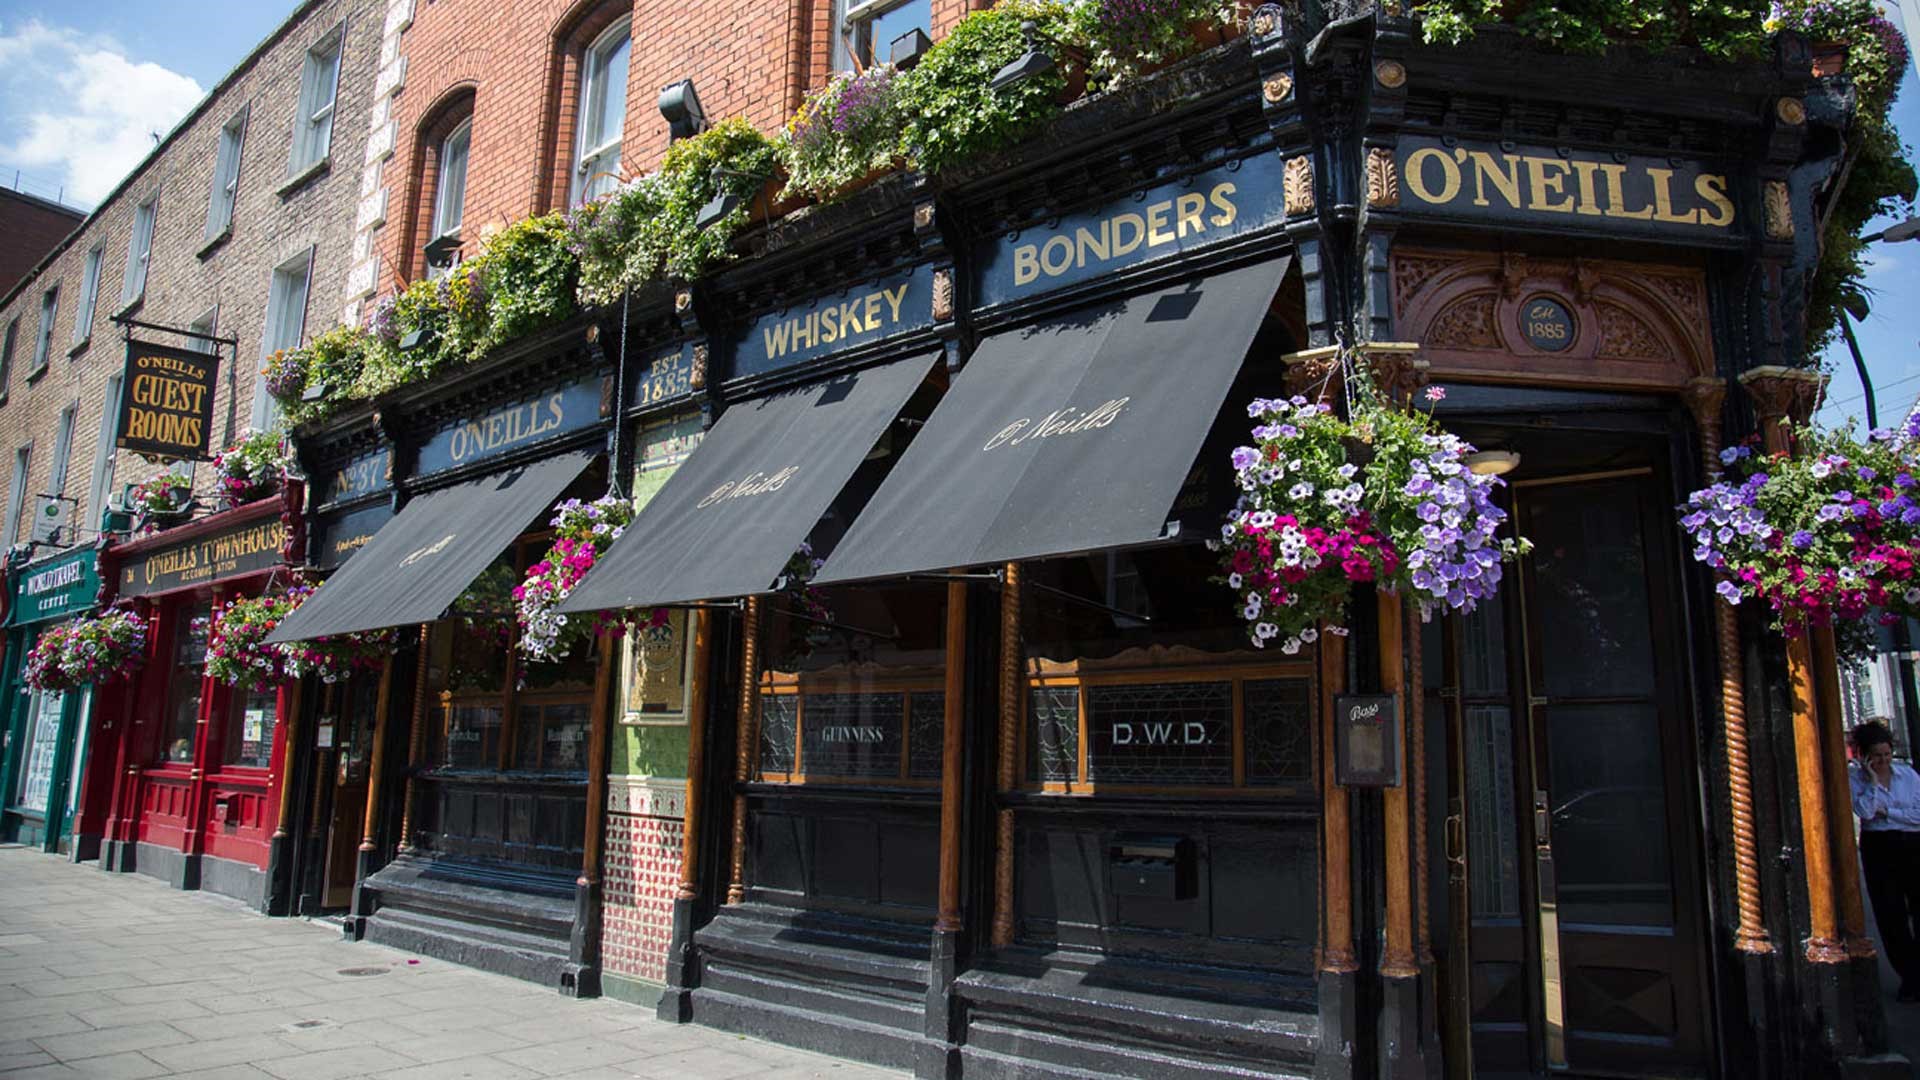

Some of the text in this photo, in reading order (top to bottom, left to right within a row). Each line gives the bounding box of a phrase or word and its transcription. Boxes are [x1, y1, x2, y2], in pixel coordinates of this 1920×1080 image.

[1404, 147, 1736, 228] O'NEILLS
[1014, 182, 1238, 287] BONDERS
[763, 283, 909, 360] WHISKEY
[1528, 322, 1566, 339] 1885
[137, 356, 206, 380] O'NEILLS
[650, 353, 682, 378] EST
[132, 374, 207, 414] GUEST
[642, 366, 689, 404] 1885
[125, 406, 202, 447] ROOMS
[450, 392, 564, 461] O'NEILLS
[356, 459, 380, 491] 37
[1349, 703, 1379, 721] Bass
[822, 726, 884, 742] GUINNESS
[1112, 722, 1213, 745] D.W.D.
